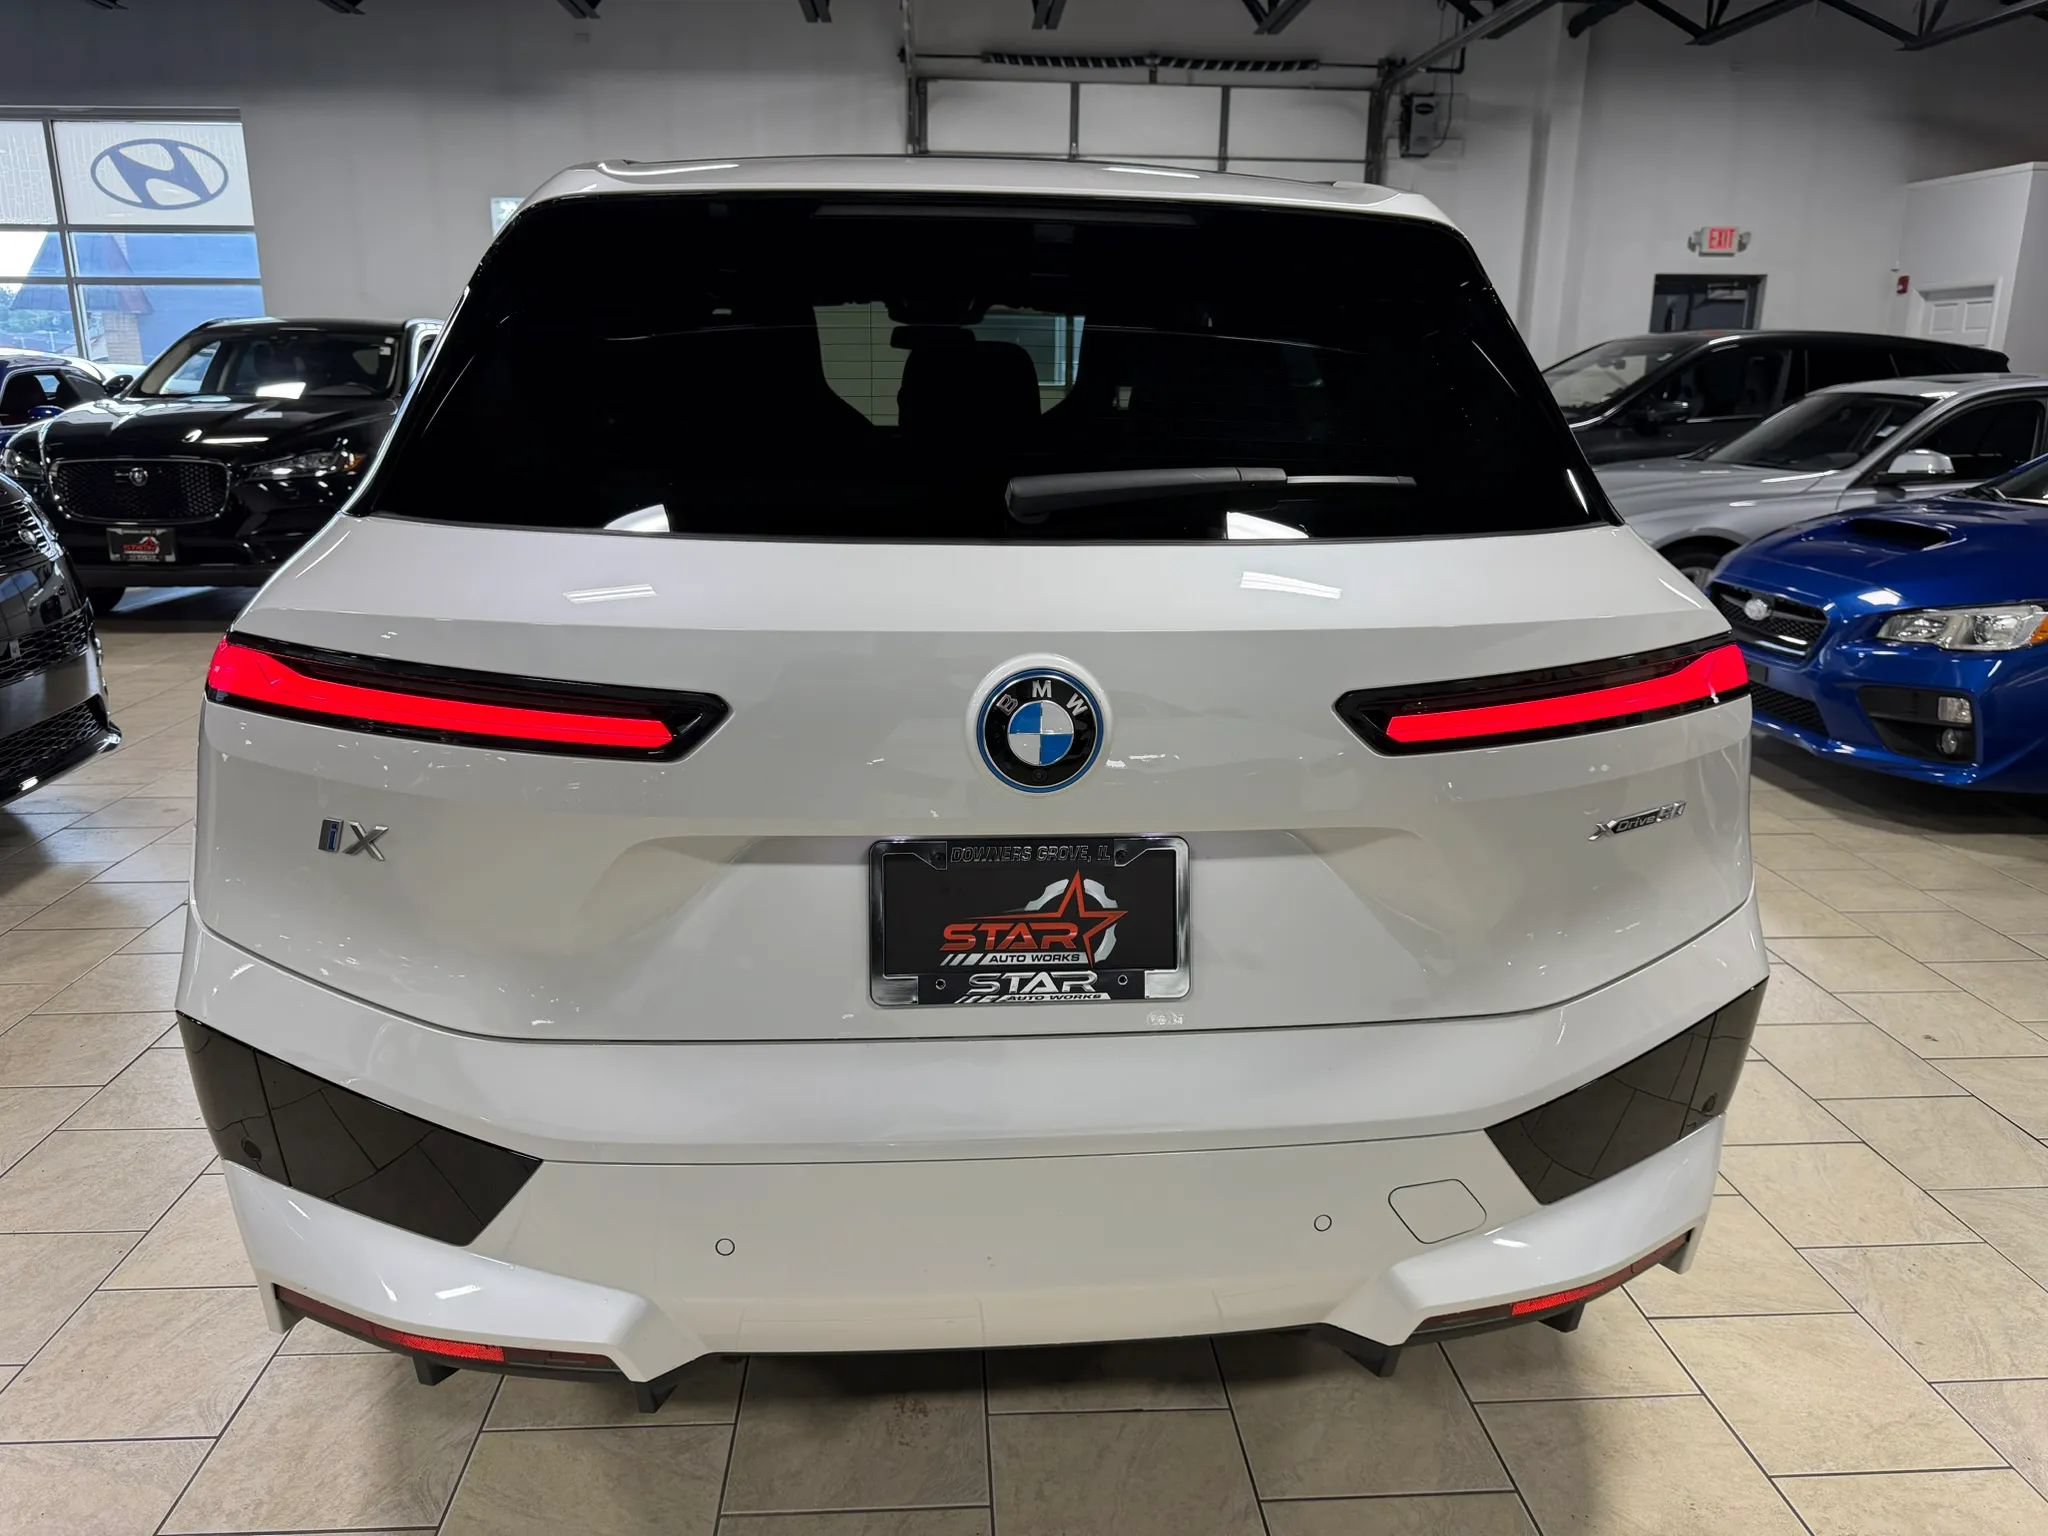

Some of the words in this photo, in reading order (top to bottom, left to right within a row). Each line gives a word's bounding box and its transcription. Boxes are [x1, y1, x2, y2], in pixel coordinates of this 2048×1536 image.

[1709, 228, 1736, 249] EXIT
[996, 679, 1088, 717] BMW
[950, 846, 1032, 863] DOWNERS
[1036, 845, 1092, 863] GROVE,
[1097, 845, 1111, 861] IL
[939, 922, 1079, 952] STAR
[988, 954, 1027, 963] AUTO
[1031, 953, 1080, 962] WORKS
[966, 970, 1098, 995] STAR
[1049, 993, 1103, 1001] WORKS
